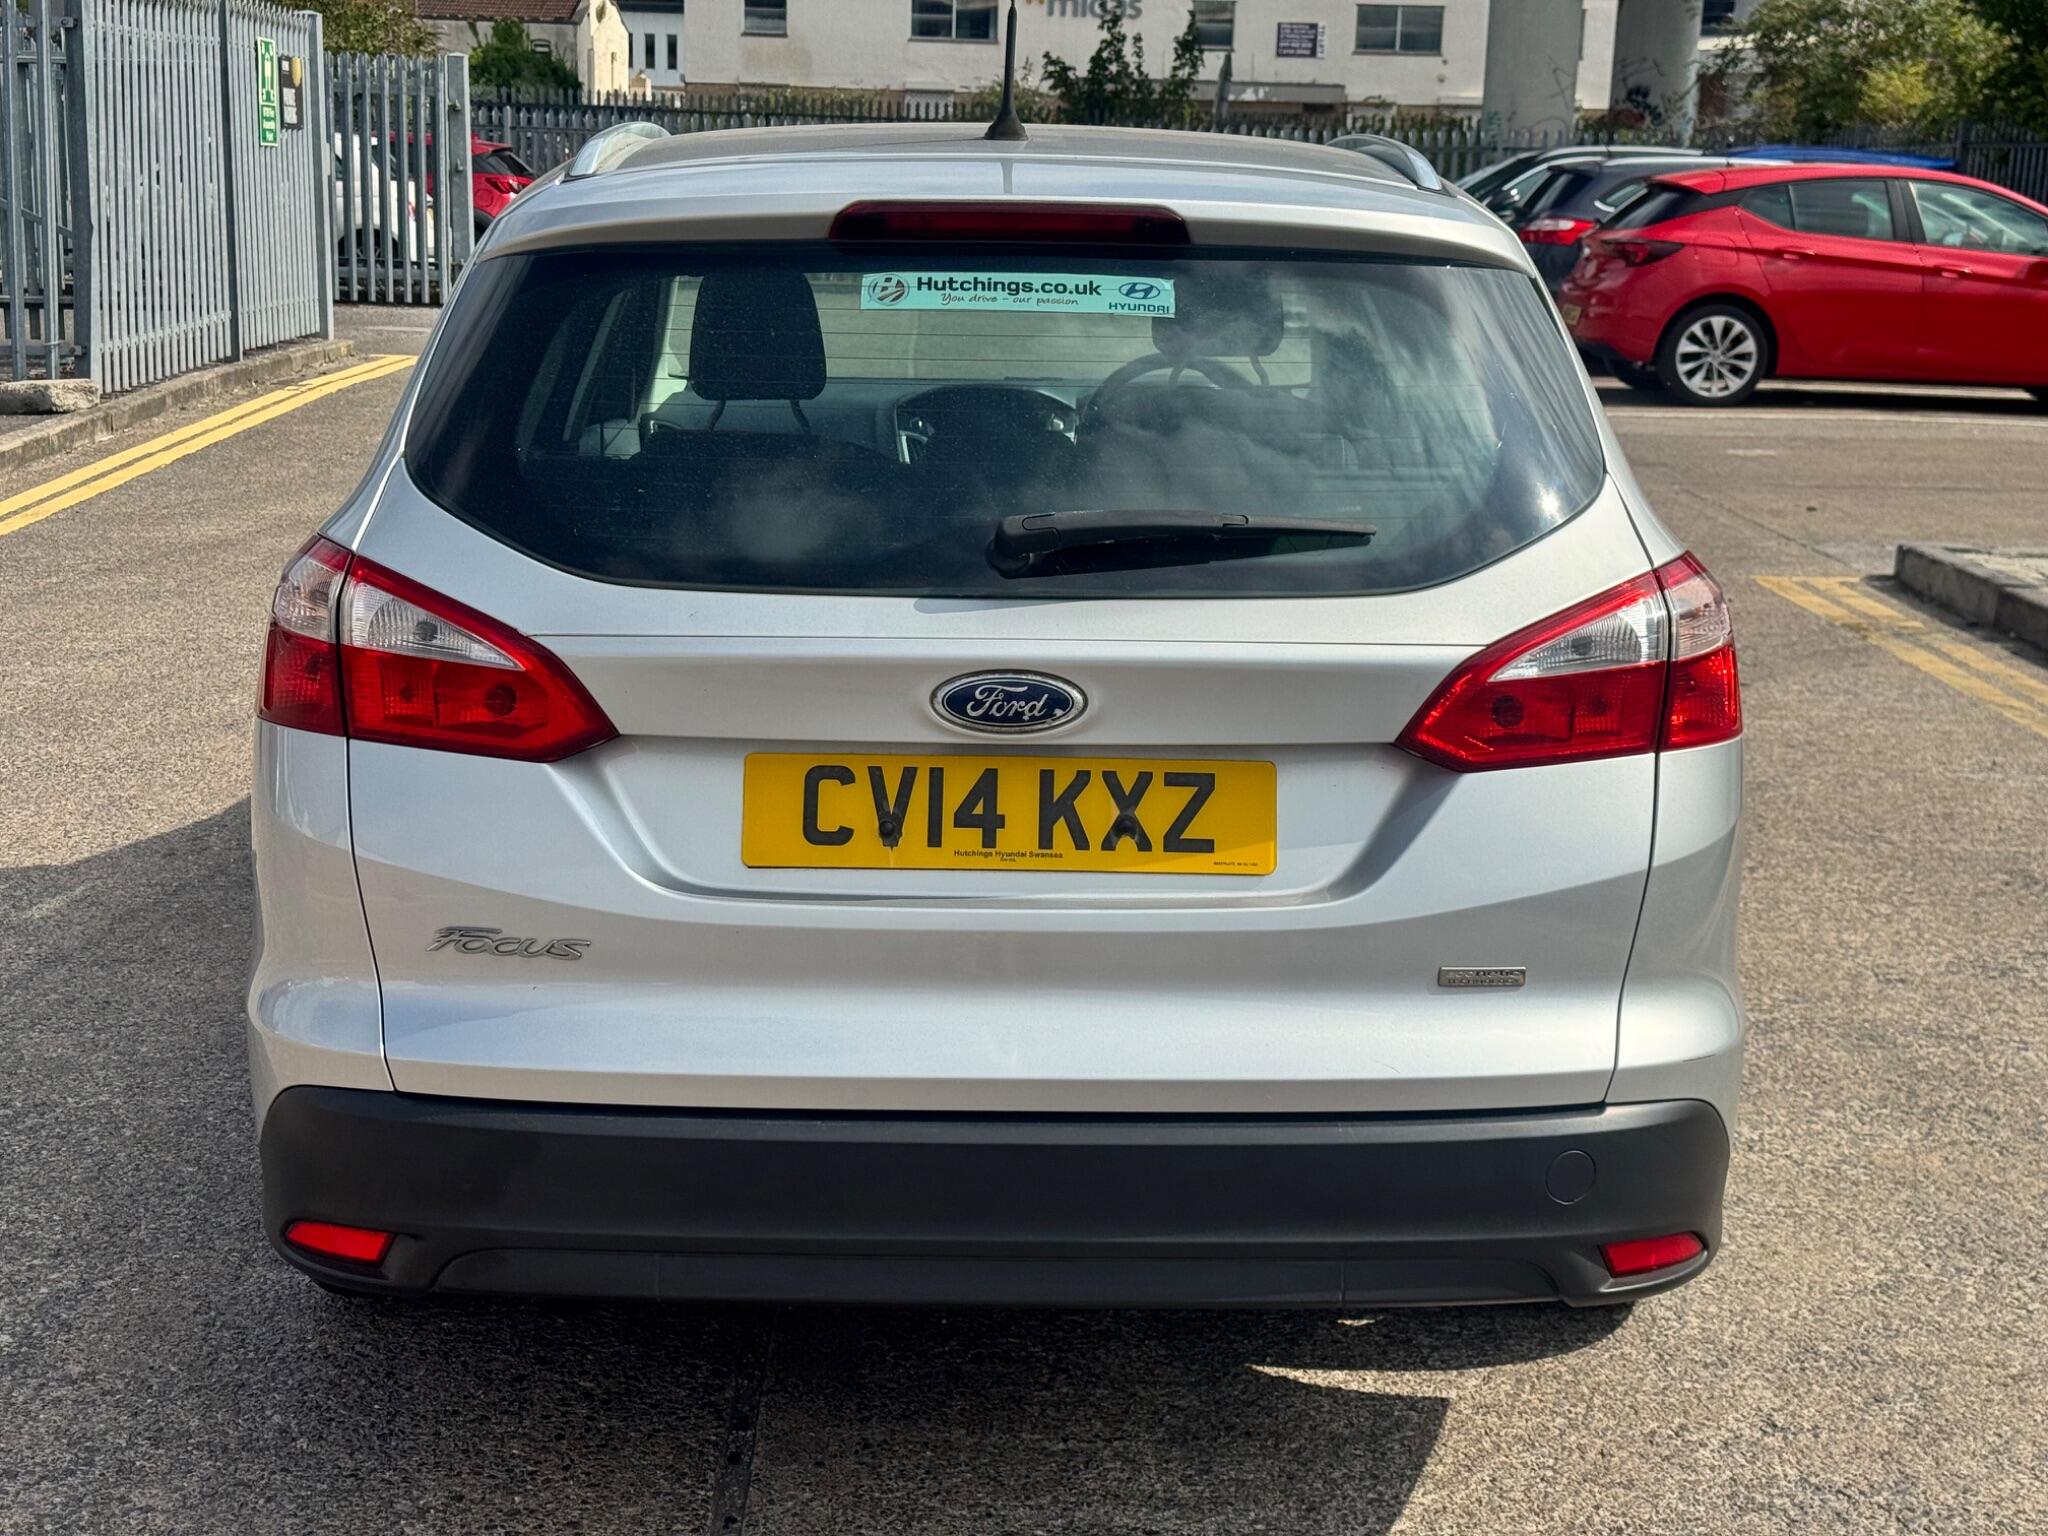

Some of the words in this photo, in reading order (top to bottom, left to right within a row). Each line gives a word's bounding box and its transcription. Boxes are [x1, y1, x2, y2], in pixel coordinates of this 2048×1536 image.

[917, 276, 1102, 296] Hutchings.co.uk
[940, 292, 966, 306] You
[968, 293, 998, 303] drive
[1012, 296, 1032, 304] our
[1036, 296, 1079, 306] passion
[1108, 302, 1170, 314] HYUNDAI
[966, 684, 1049, 718] Ford
[802, 764, 1006, 850] CV14
[1038, 768, 1216, 853] KXZ
[954, 849, 993, 859] Hutchings
[995, 850, 1027, 859] Hyundai
[1029, 850, 1063, 859] Swansea
